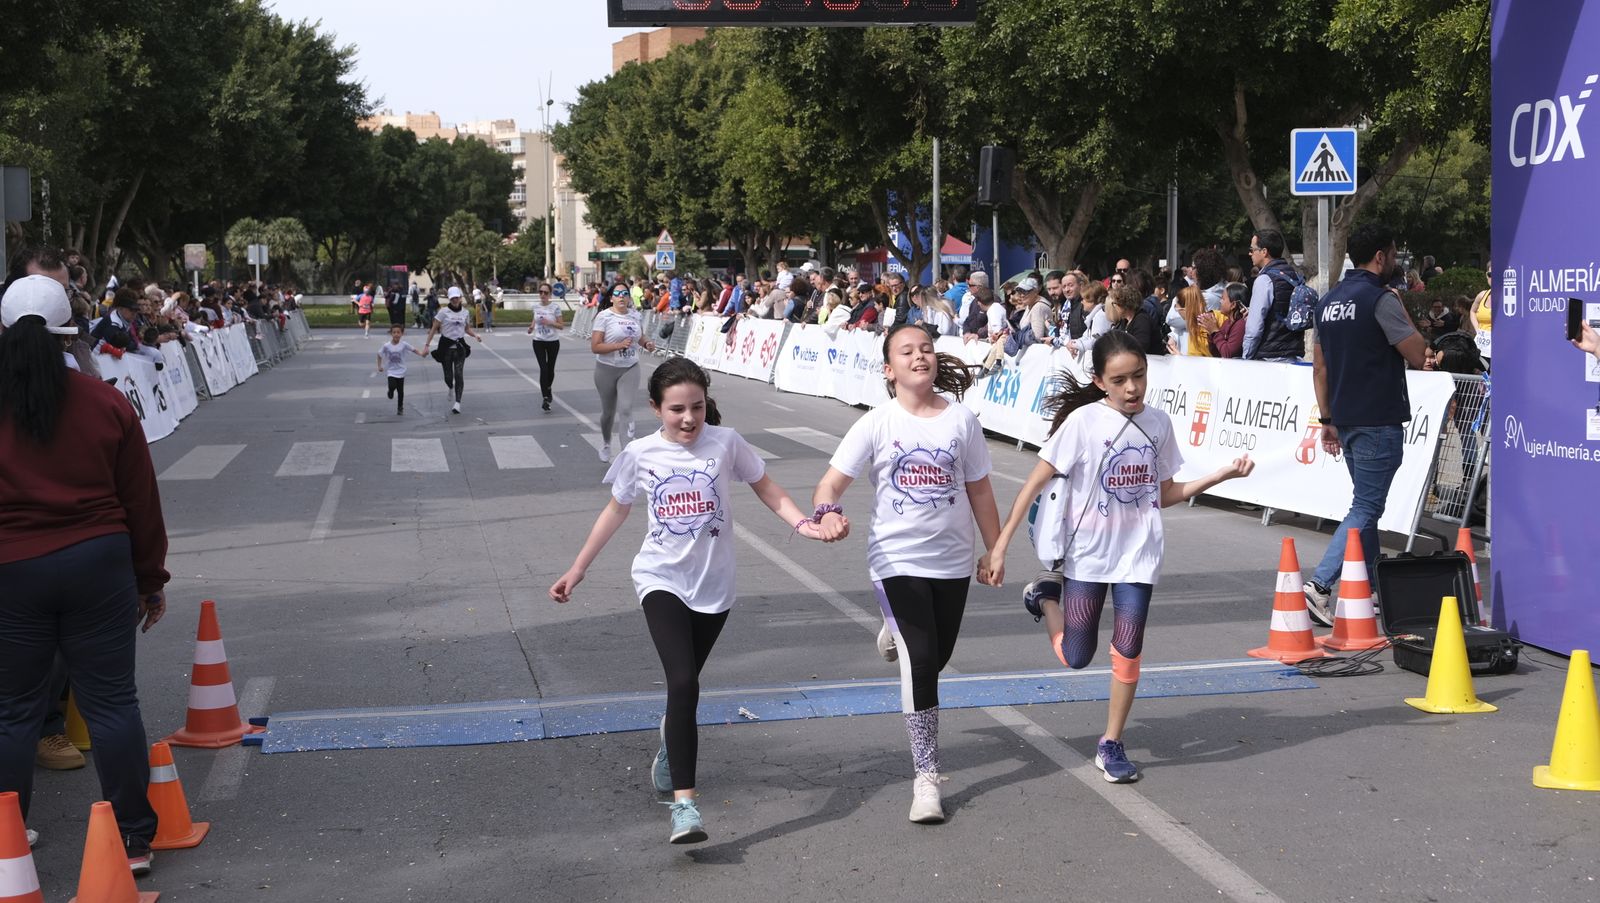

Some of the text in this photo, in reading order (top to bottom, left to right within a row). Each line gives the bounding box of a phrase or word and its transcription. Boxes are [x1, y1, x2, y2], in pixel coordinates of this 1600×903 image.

[1509, 92, 1587, 168] CDX
[1528, 262, 1600, 293] ALMERÍA
[1528, 297, 1566, 313] CIUDAD
[760, 332, 777, 368] ego
[1222, 396, 1299, 433] ALMERÍA
[1218, 428, 1257, 451] CIUDAD
[911, 464, 942, 475] MINI
[1120, 464, 1149, 475] MINI
[900, 474, 952, 486] RUNNER
[667, 491, 702, 505] MINI
[658, 501, 715, 517] RUNNER
